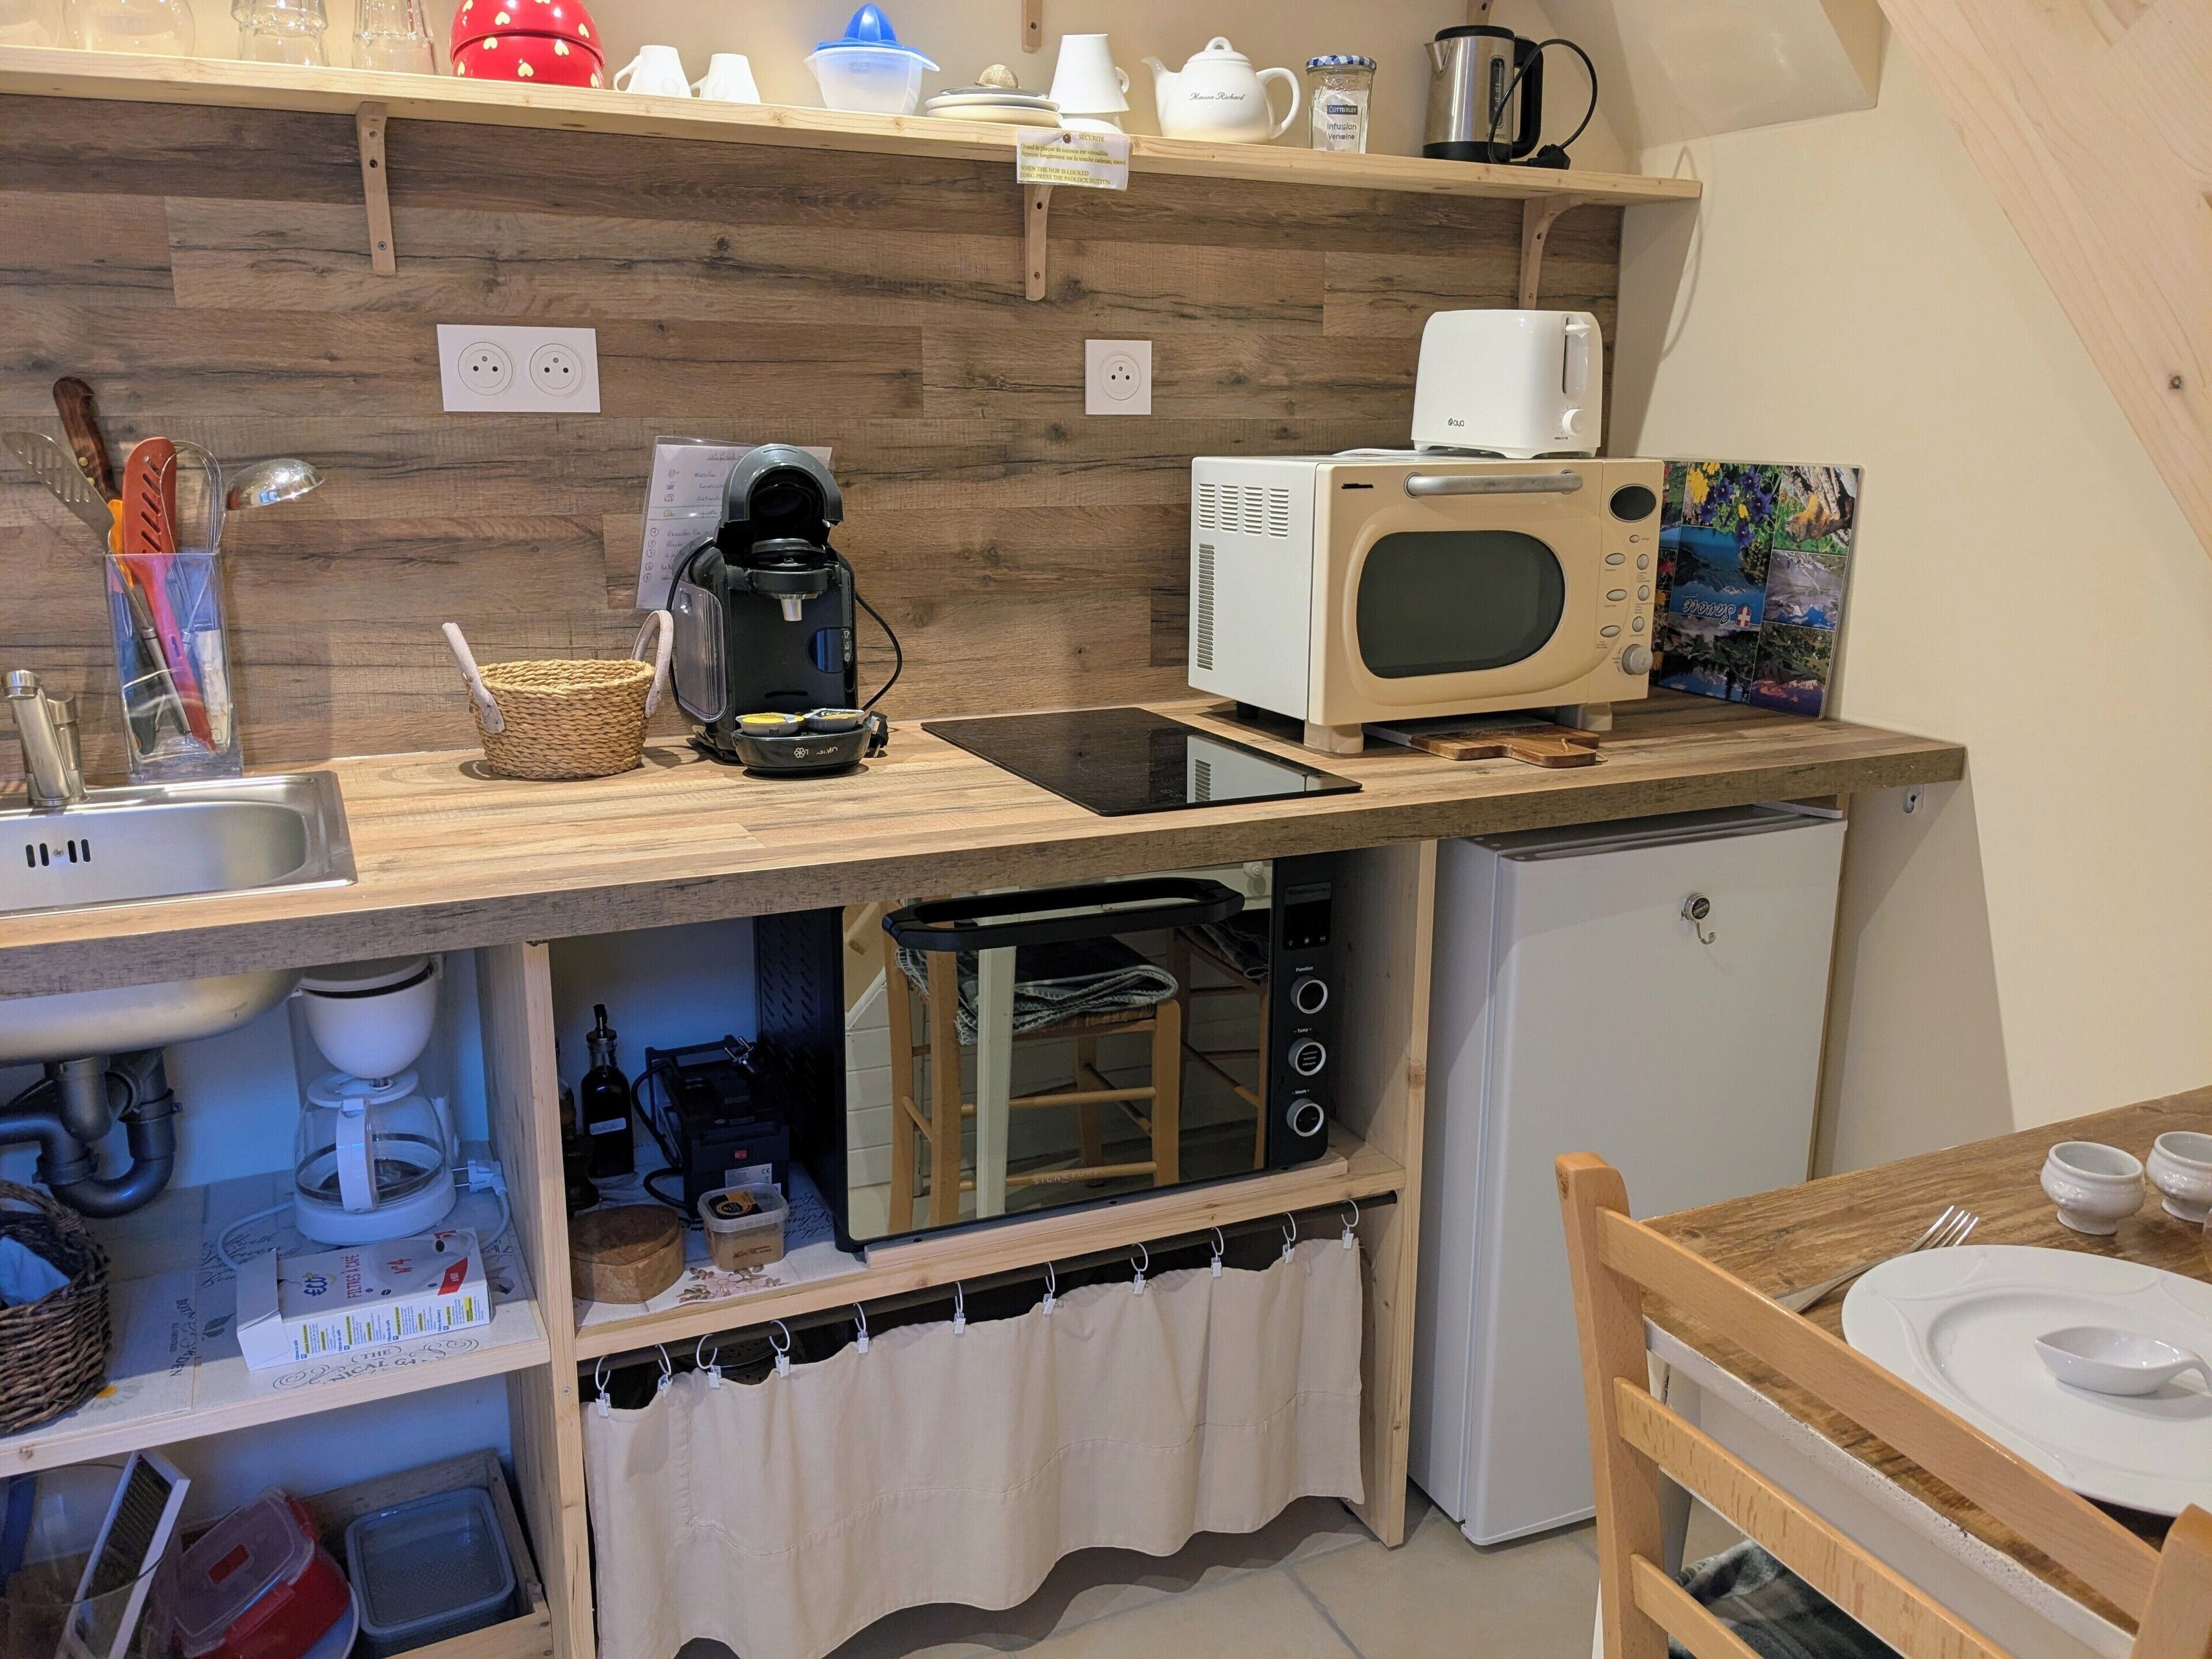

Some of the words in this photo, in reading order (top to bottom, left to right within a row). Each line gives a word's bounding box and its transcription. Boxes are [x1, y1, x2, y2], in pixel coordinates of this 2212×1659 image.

[1215, 92, 1245, 100] Richard
[1683, 599, 1736, 626] Savoie
[346, 1273, 362, 1298] FILTRES
[360, 1349, 391, 1360] THE
